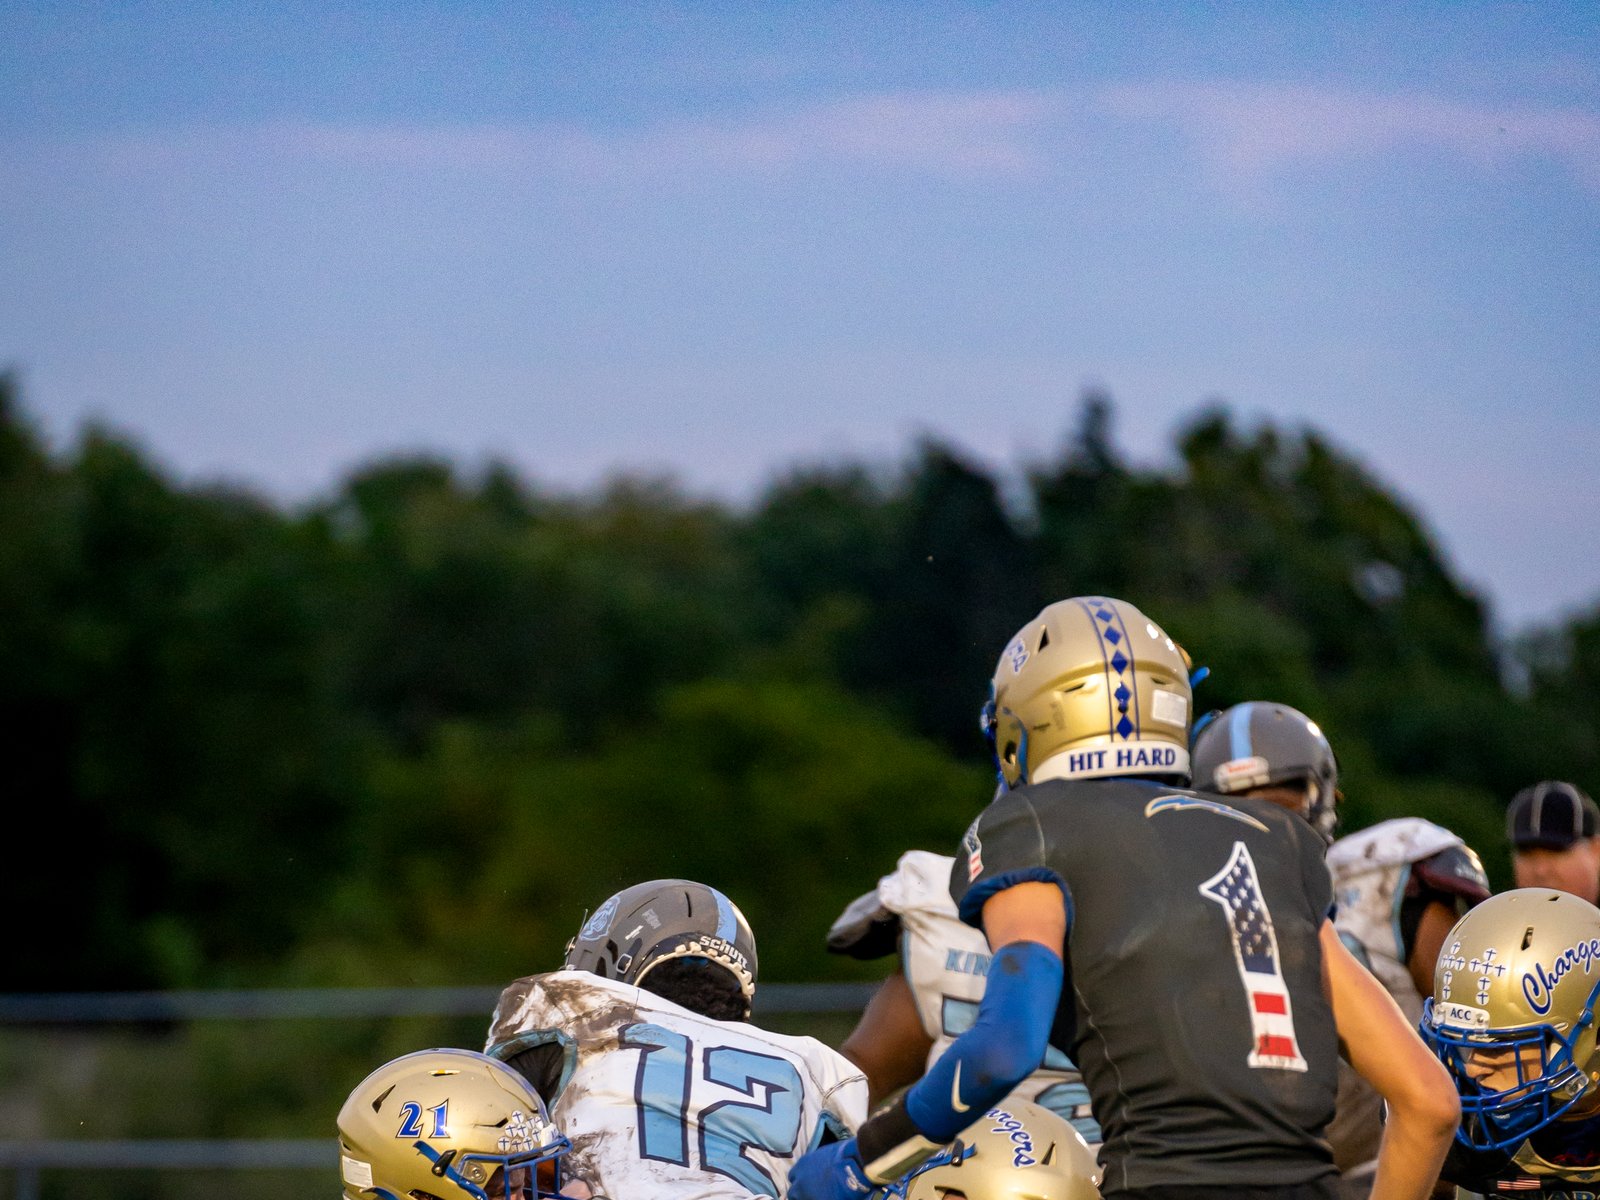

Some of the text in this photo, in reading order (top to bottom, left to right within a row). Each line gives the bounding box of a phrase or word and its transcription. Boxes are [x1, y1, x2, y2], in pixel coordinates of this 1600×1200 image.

[1069, 748, 1176, 772] HIT HARD
[1199, 840, 1308, 1072] 1
[1450, 1007, 1472, 1021] ACC
[395, 1098, 450, 1139] 21
